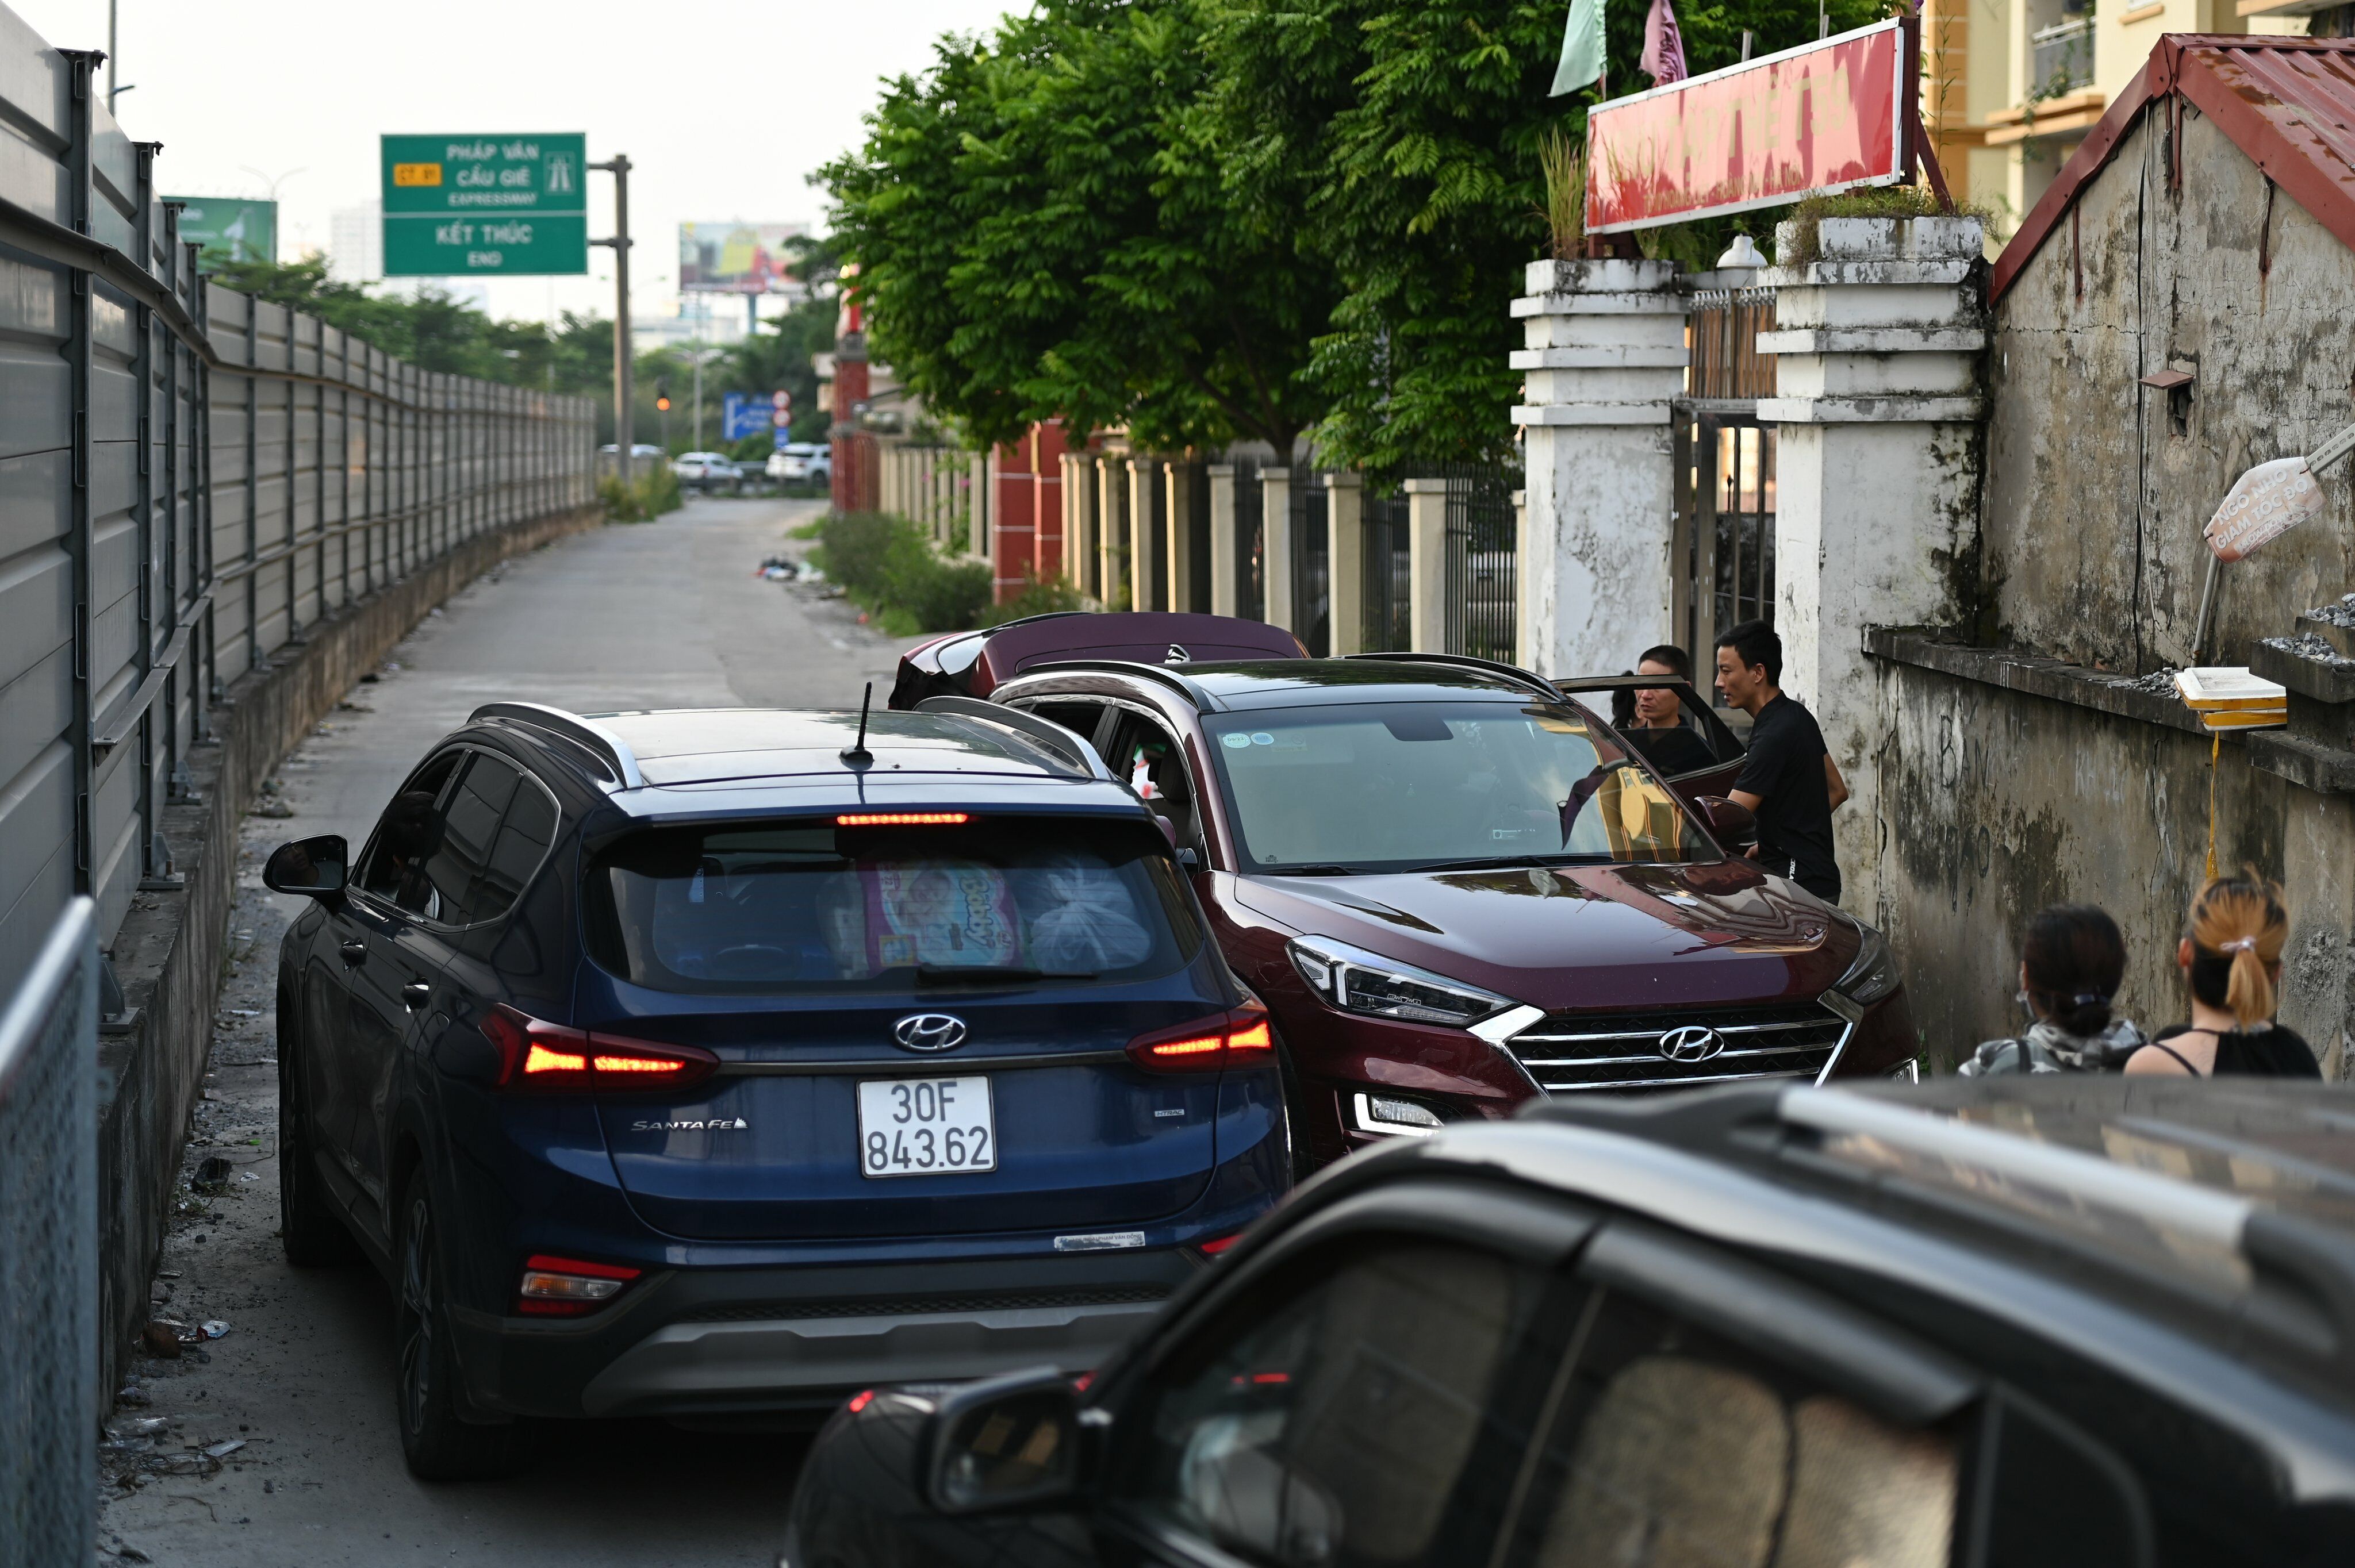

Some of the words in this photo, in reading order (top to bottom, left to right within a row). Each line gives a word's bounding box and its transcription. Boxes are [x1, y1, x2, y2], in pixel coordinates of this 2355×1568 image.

[1791, 66, 1850, 141] T59
[446, 139, 497, 162] PHÁP
[502, 140, 540, 160] VÂN
[448, 191, 538, 206] EXPRESSWAY
[435, 218, 474, 244] KẾT
[481, 220, 534, 244] THÚC
[467, 252, 503, 267] END
[2215, 516, 2252, 549] GIẢM
[2251, 493, 2283, 521] TỐC
[2282, 476, 2308, 500] ĐỘ
[2216, 491, 2250, 526] NGÕ
[959, 876, 996, 948] Bobby
[891, 1082, 957, 1123] 30F
[631, 1120, 704, 1131] SANTA
[707, 1120, 733, 1129] FE
[868, 1126, 989, 1170] 843.62
